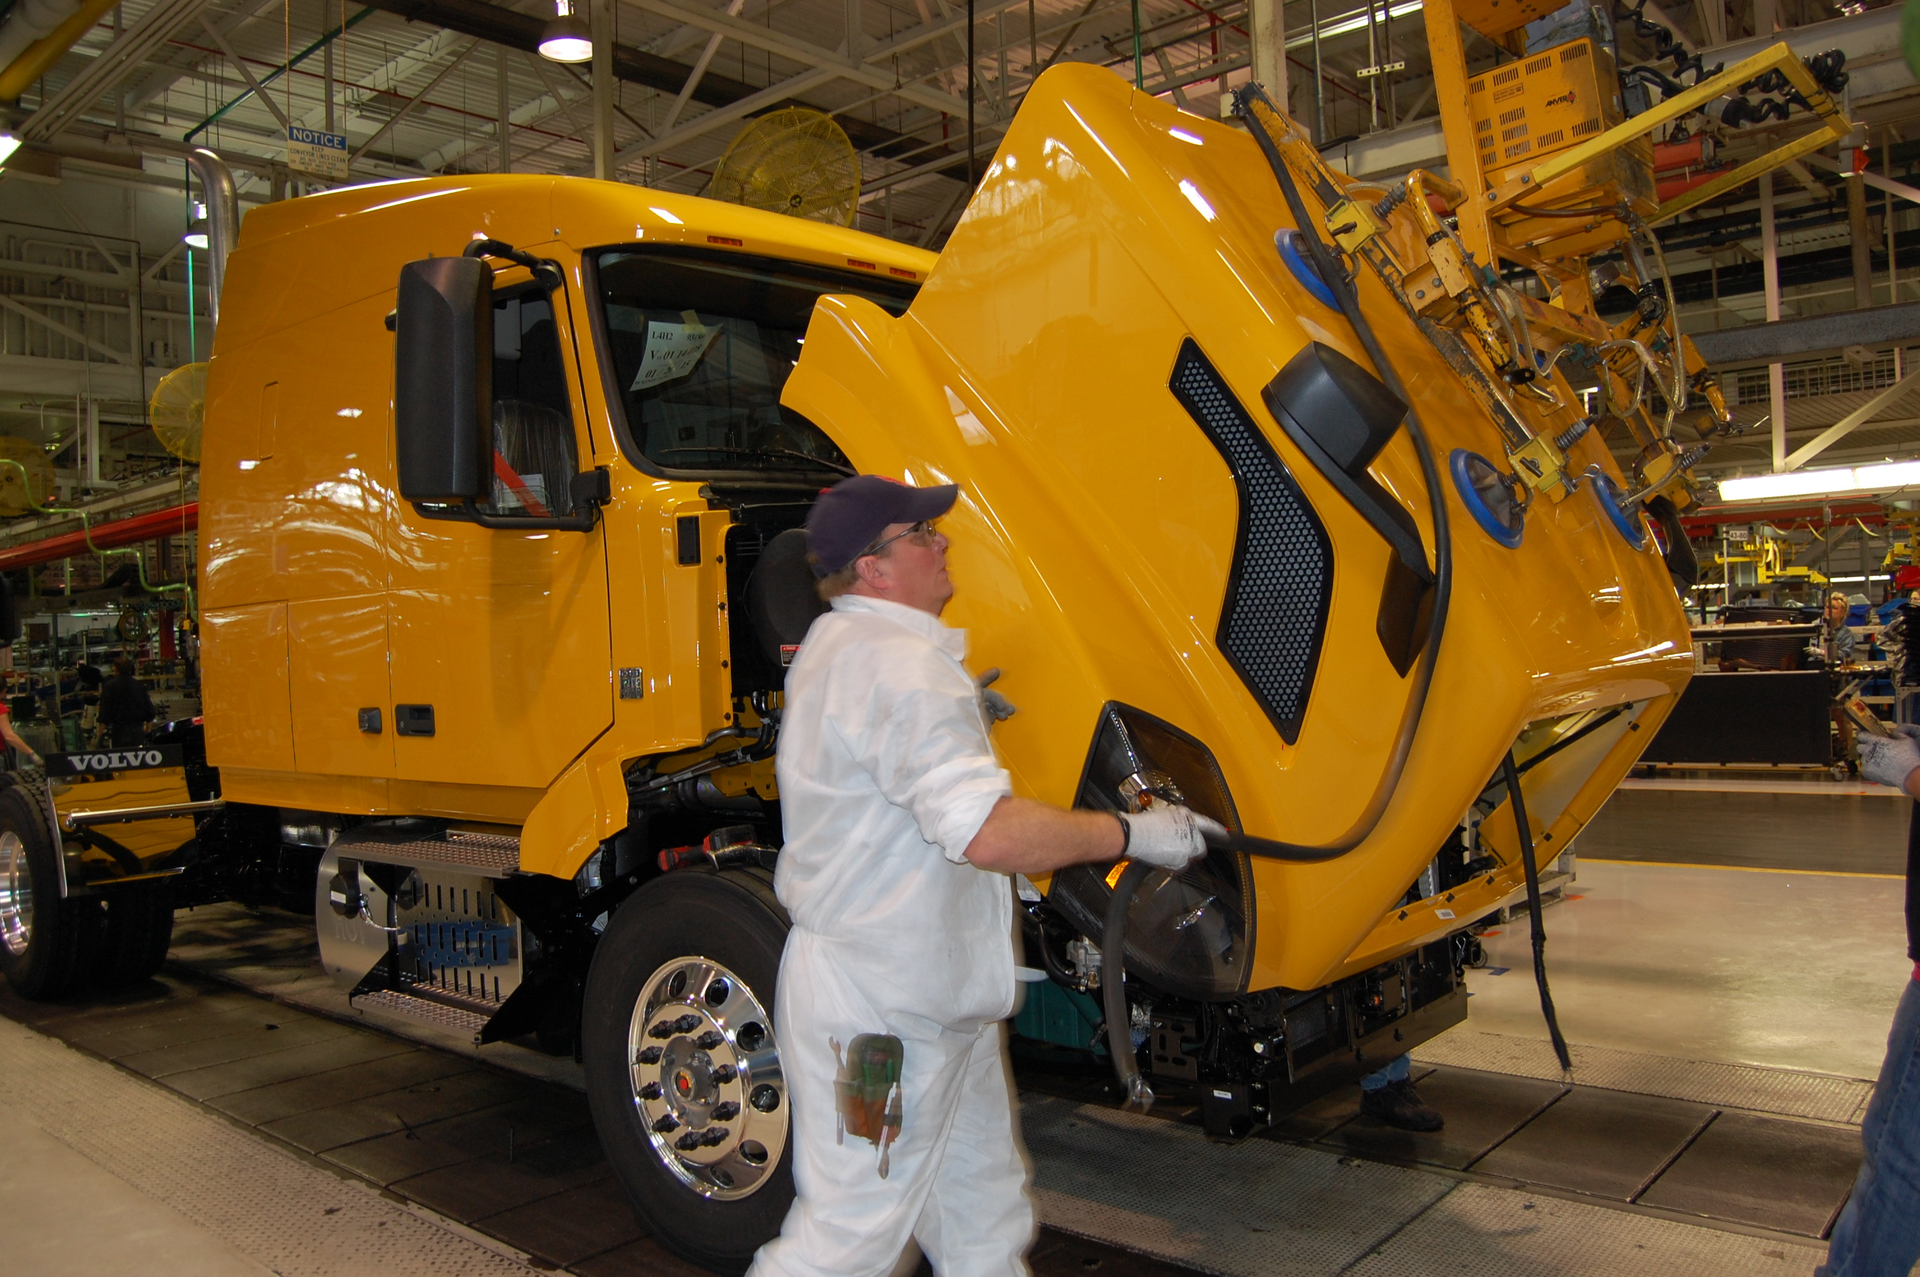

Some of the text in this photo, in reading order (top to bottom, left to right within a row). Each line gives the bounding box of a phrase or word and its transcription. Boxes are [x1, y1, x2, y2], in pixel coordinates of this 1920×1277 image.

[293, 128, 342, 148] NOTICE
[290, 148, 315, 158] CONVEYOR
[330, 155, 346, 163] CLEAN
[68, 750, 163, 771] VOLVO
